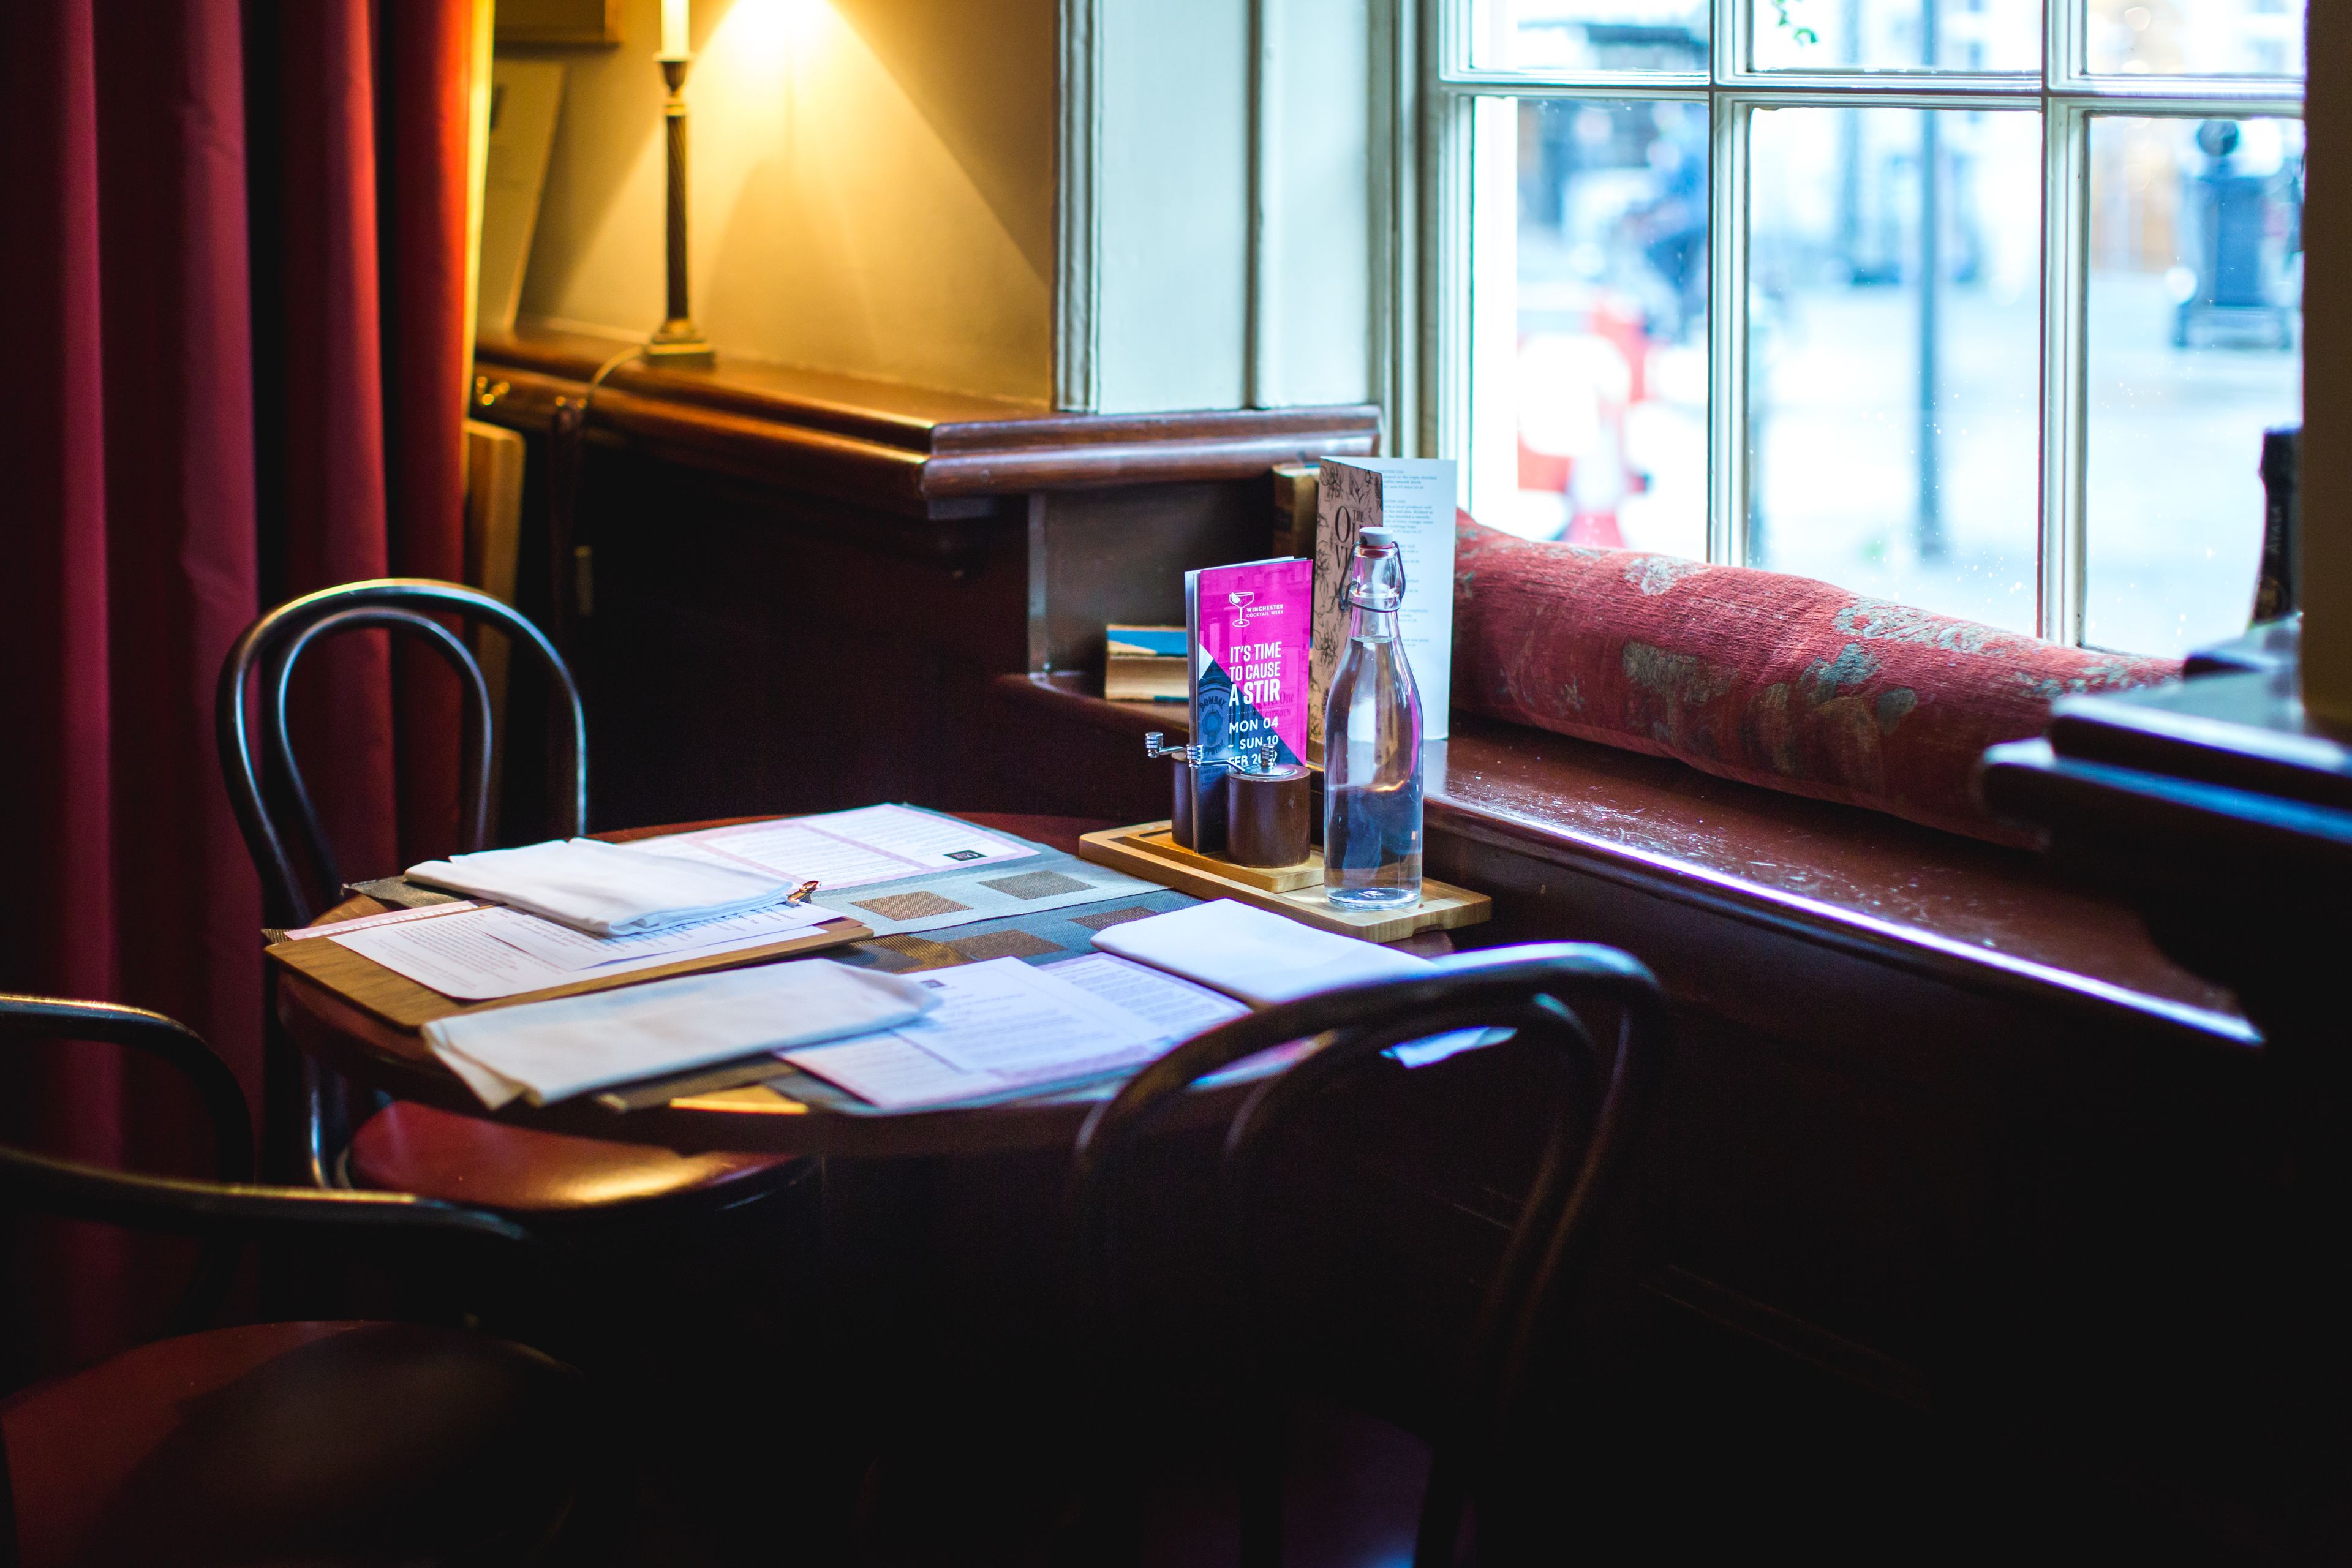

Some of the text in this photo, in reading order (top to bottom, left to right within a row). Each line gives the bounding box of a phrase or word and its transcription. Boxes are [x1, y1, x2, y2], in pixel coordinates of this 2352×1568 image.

[1352, 509, 1364, 523] THE
[1246, 603, 1284, 612] WINCHESTER
[1253, 641, 1282, 661] TIME
[1229, 660, 1281, 682] TO CAUSE
[1228, 685, 1239, 707] A
[1243, 679, 1281, 706] STIR
[1229, 715, 1279, 734] MON 04
[1239, 736, 1263, 750] SUN
[1267, 734, 1279, 745] 10
